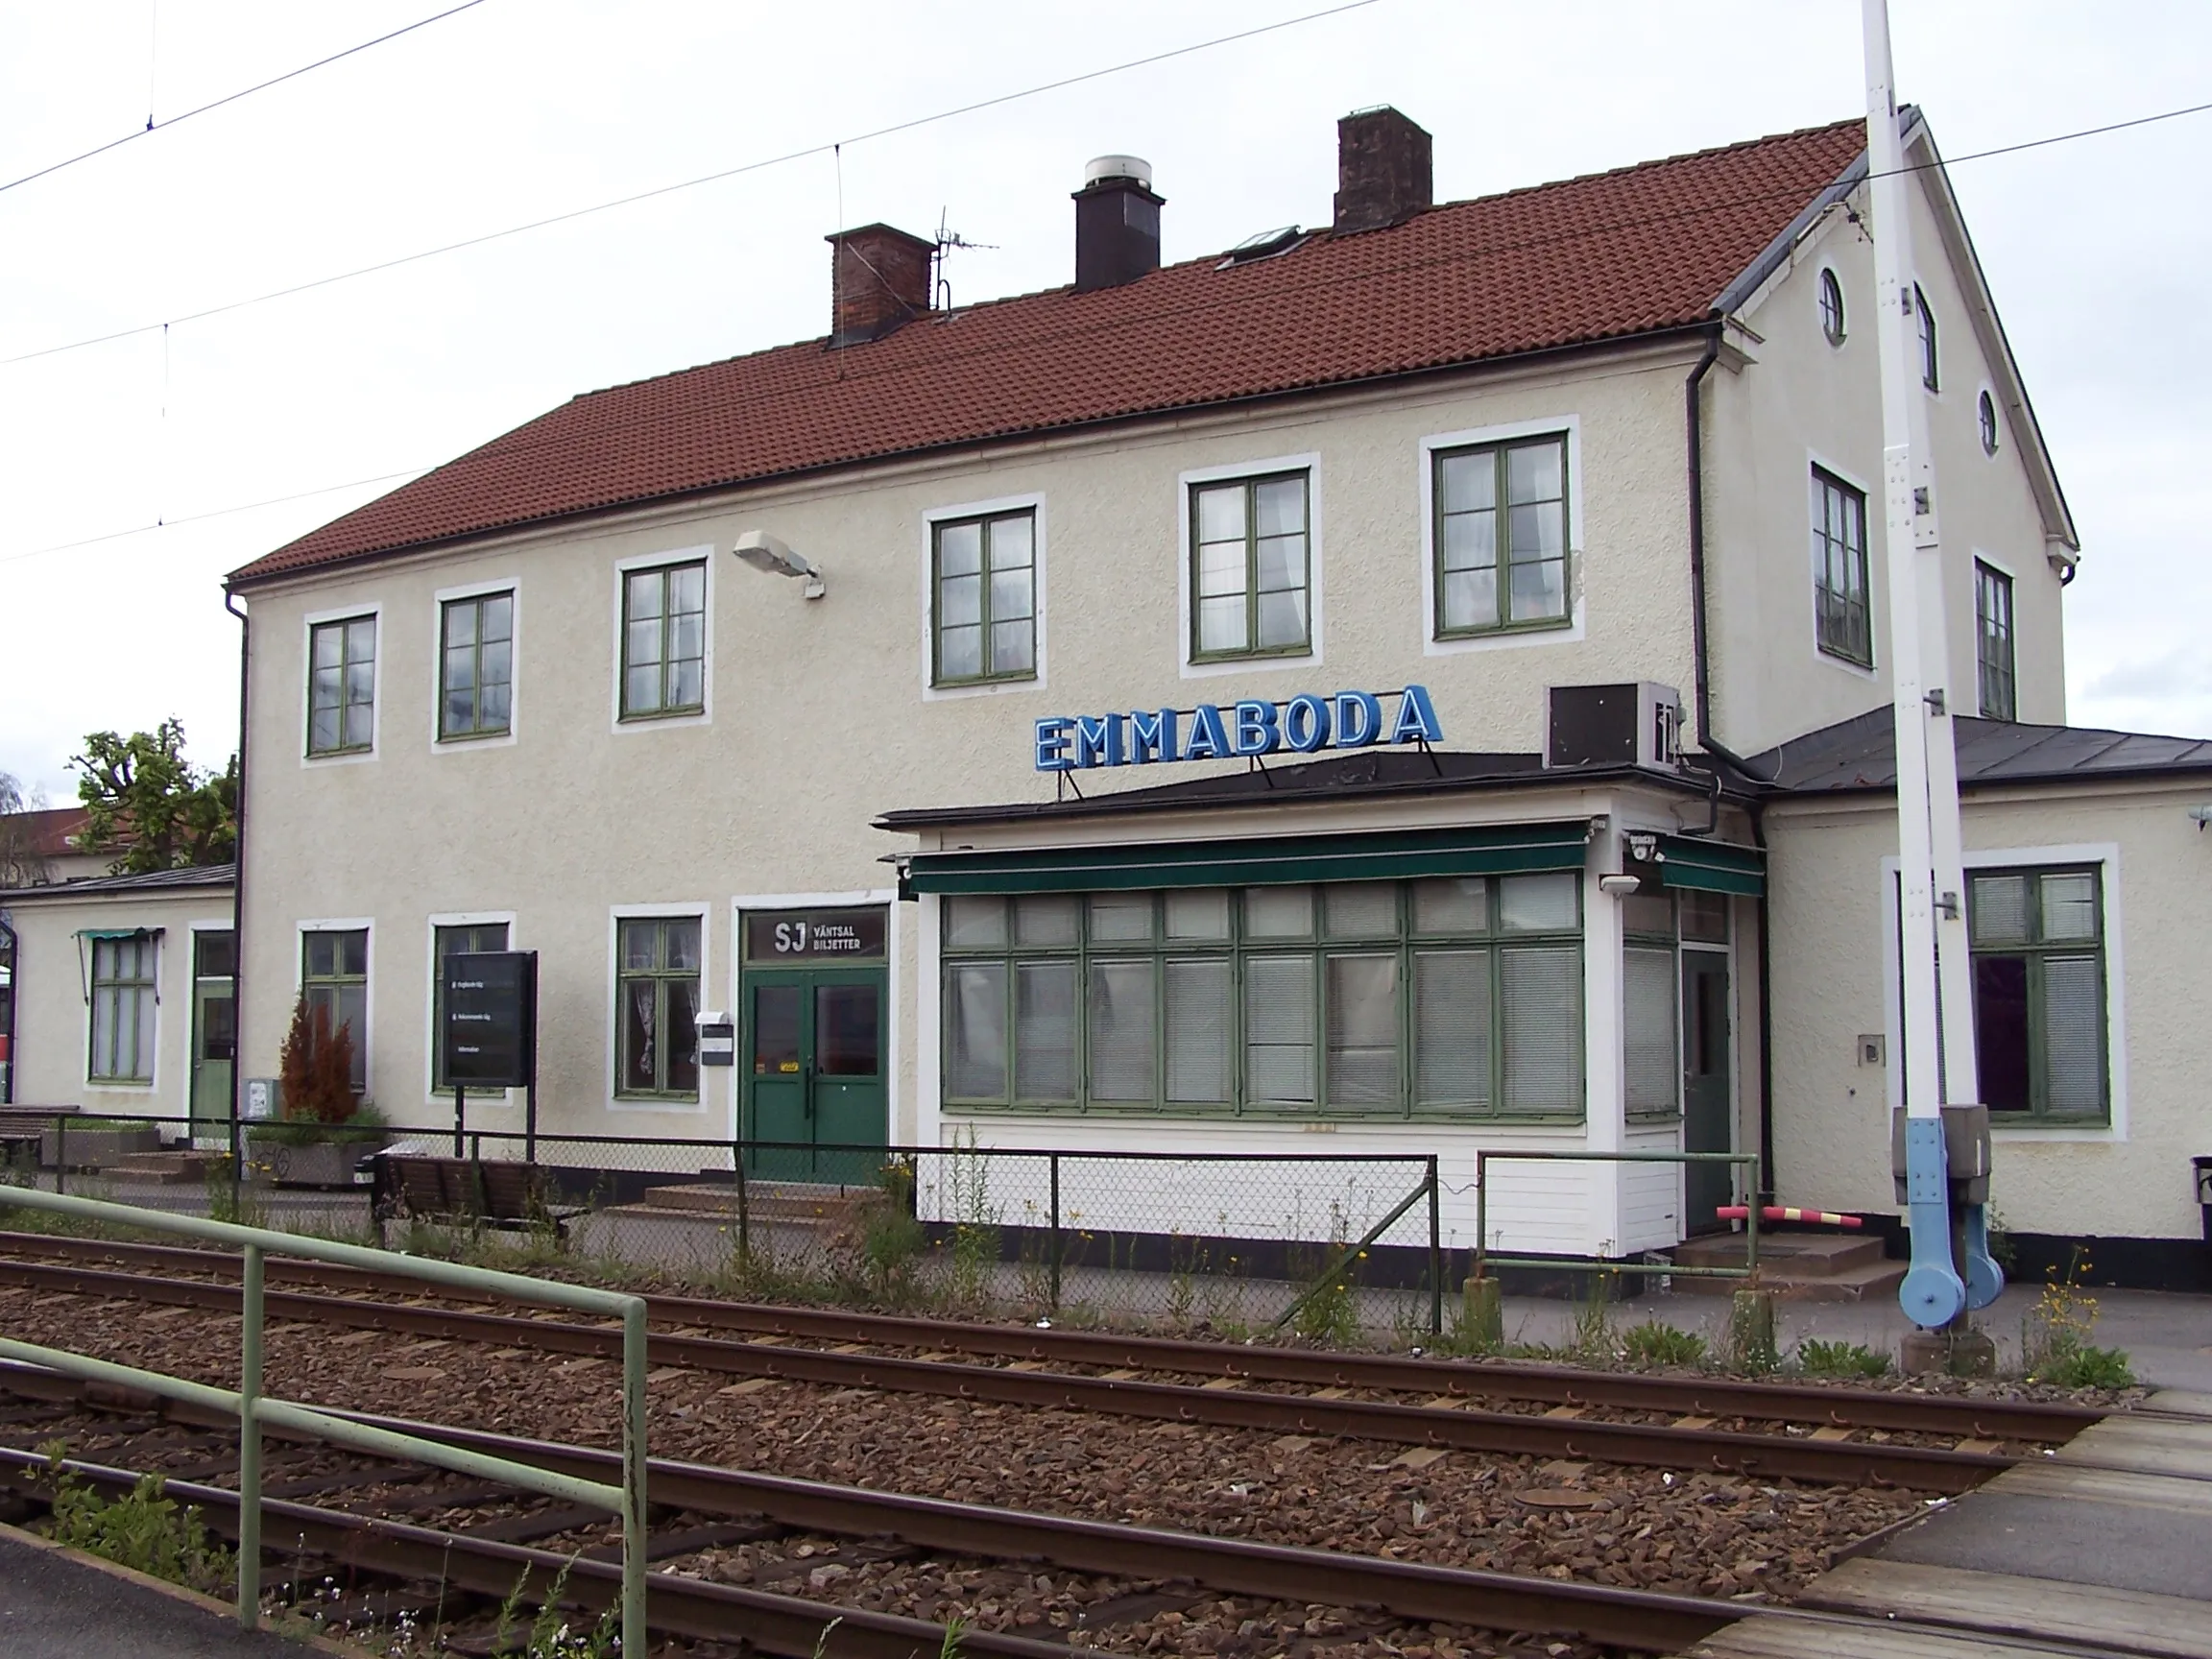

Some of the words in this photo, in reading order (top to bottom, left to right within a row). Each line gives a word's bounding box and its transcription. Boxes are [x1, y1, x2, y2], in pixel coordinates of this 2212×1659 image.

[1035, 685, 1444, 771] EMMABODA
[775, 922, 806, 952] SJ
[813, 925, 854, 937] VÄNTSAL
[813, 939, 860, 950] BILJETTER
